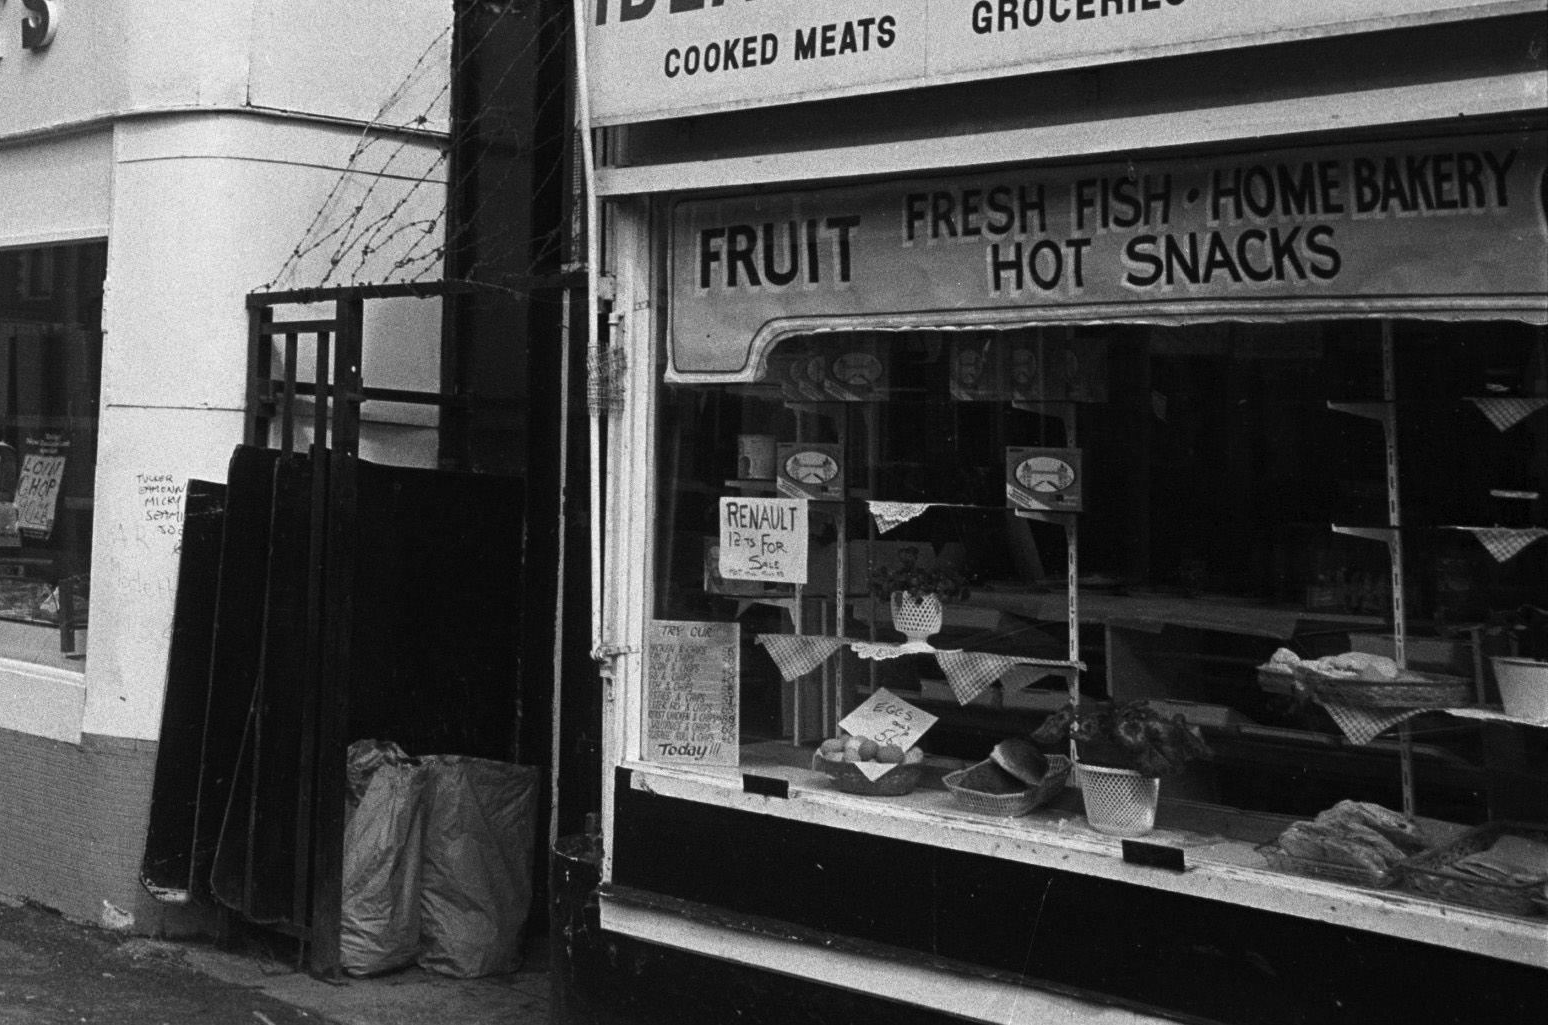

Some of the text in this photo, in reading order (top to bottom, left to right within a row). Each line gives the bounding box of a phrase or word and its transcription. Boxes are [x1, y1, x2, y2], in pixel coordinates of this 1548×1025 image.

[664, 31, 779, 79] COOKED
[794, 13, 898, 63] MEATS
[902, 182, 1049, 246] FRESH
[1072, 172, 1173, 233] FISH
[1209, 158, 1345, 223] HOME
[1353, 148, 1518, 219] BAKERY
[697, 214, 861, 296] FRUIT
[989, 224, 1342, 296] HOT SNACKS
[726, 502, 798, 532] RENAULT
[761, 533, 788, 556] FOR
[661, 625, 684, 637] TRY
[873, 702, 913, 721] EGGS
